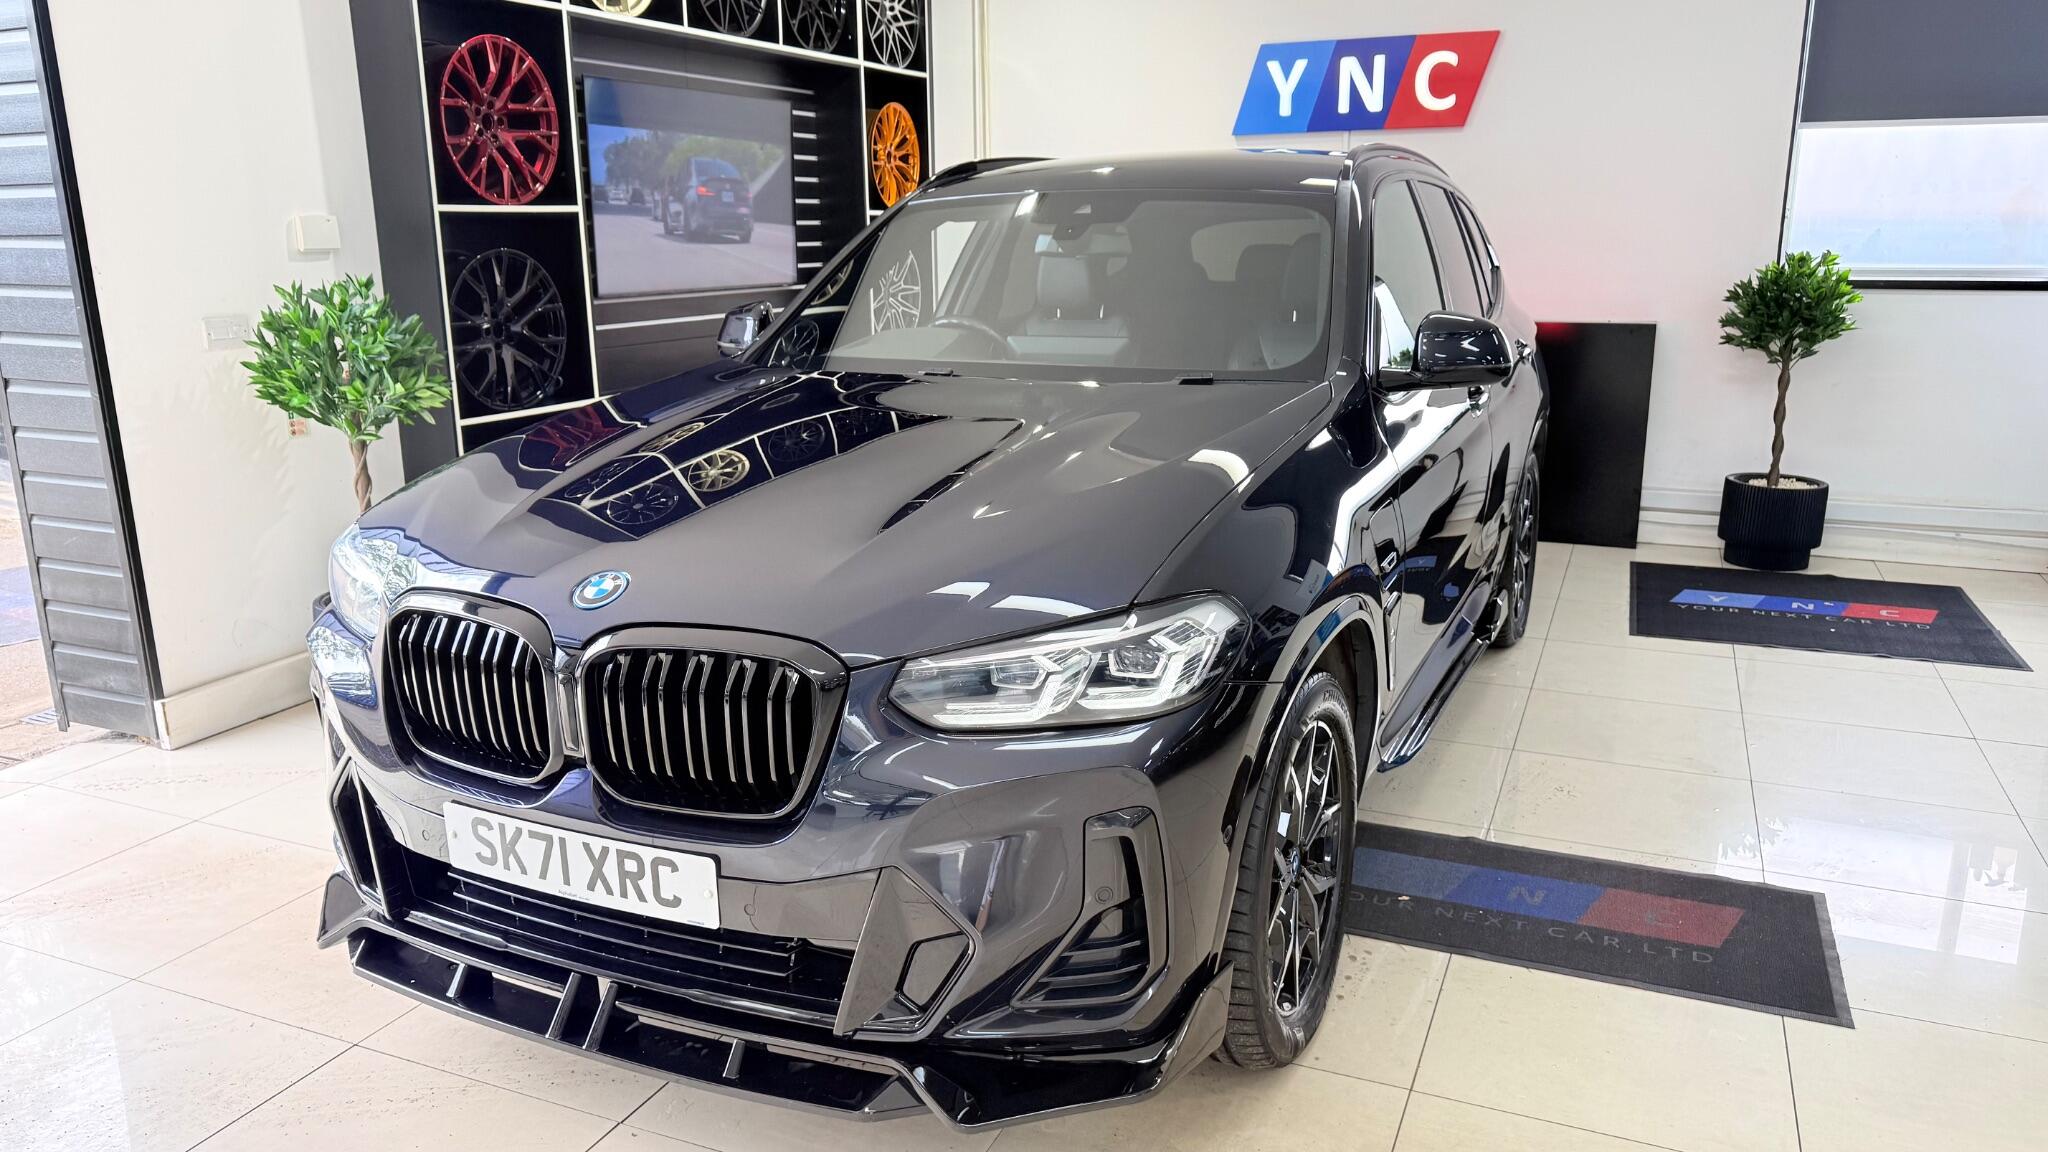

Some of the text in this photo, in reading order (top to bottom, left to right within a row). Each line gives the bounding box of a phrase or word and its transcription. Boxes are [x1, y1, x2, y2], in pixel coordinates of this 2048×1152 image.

[1266, 50, 1459, 117] YNC
[1677, 604, 1931, 629] YOUR NEXT CAR LTD
[471, 816, 683, 909] SK71 XRC
[1435, 907, 1529, 931] NEXT
[1643, 943, 1714, 964] LTD
